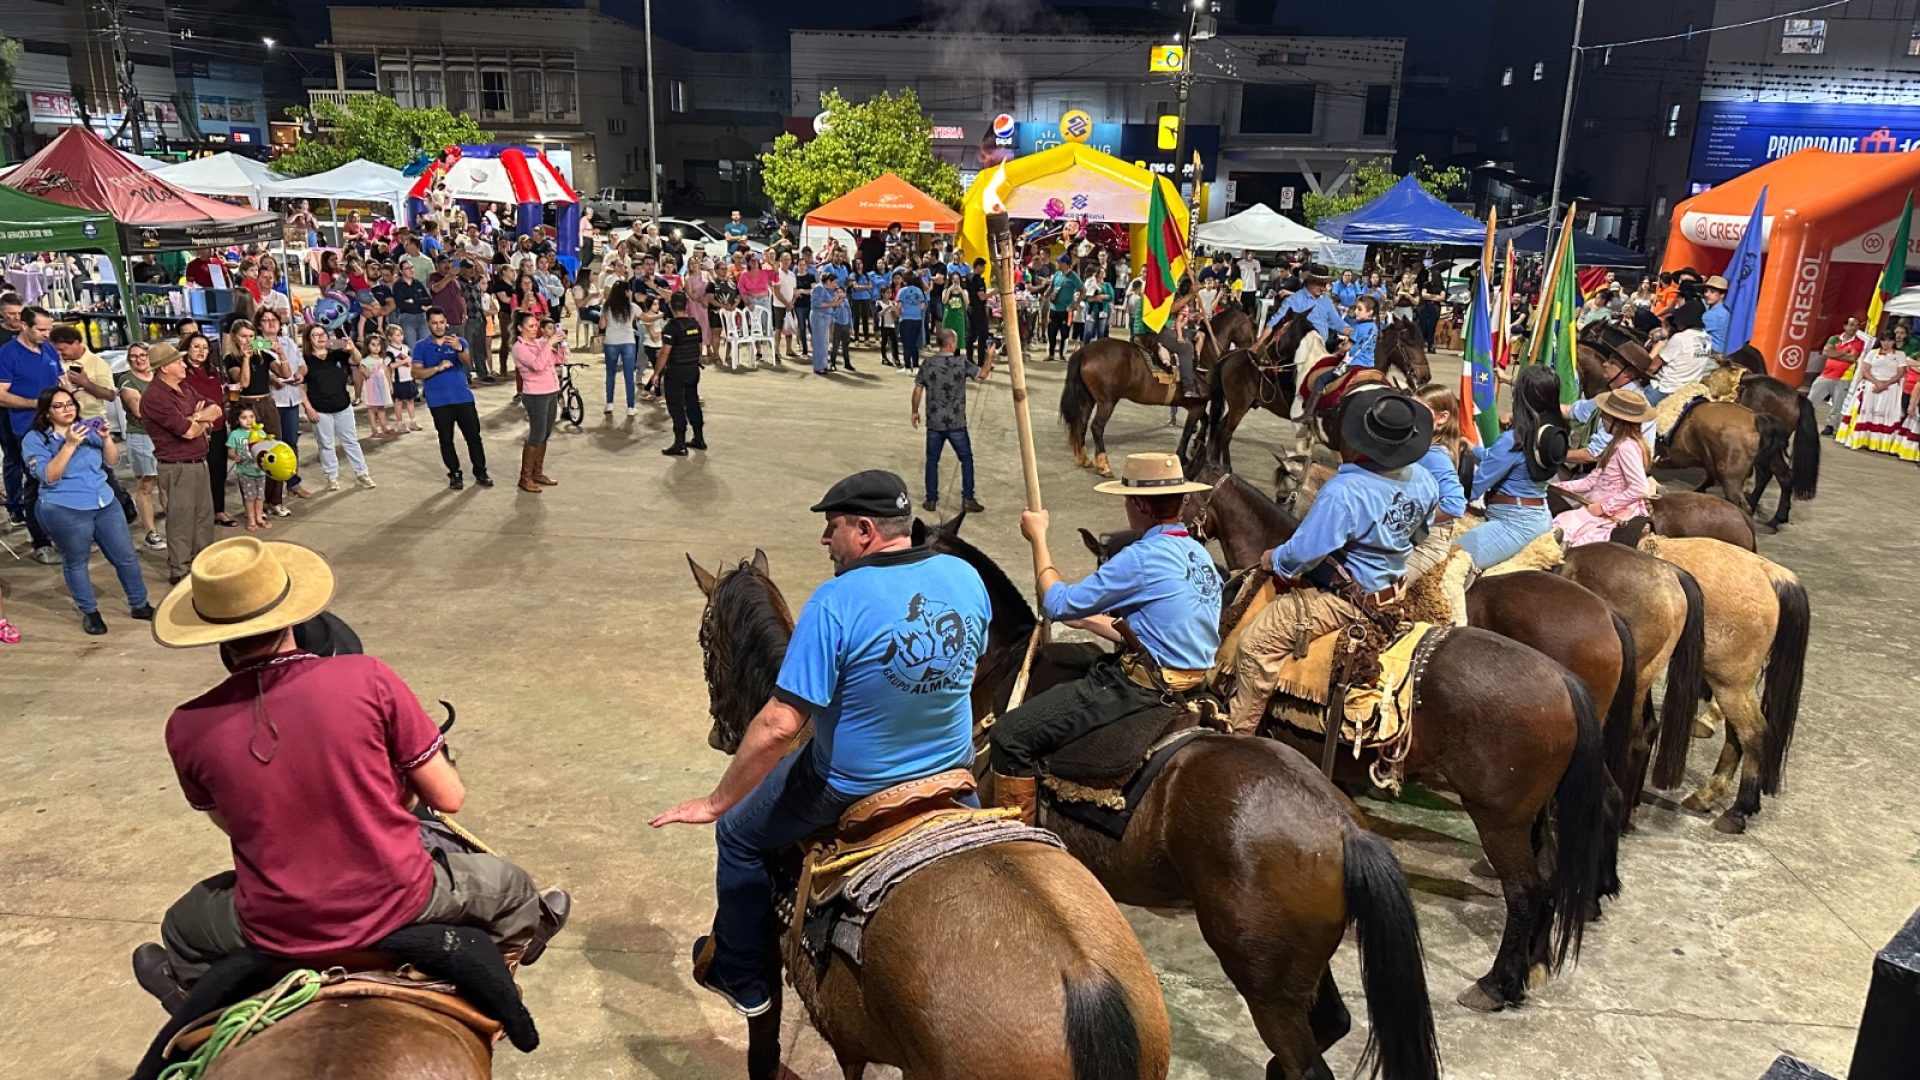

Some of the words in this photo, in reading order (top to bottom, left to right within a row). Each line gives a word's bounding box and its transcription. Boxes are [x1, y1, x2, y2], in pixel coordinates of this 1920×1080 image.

[928, 126, 965, 139] TERIA
[1789, 251, 1823, 341] CRESOL
[883, 668, 911, 693] GRUPO
[911, 676, 952, 695] ALMA
